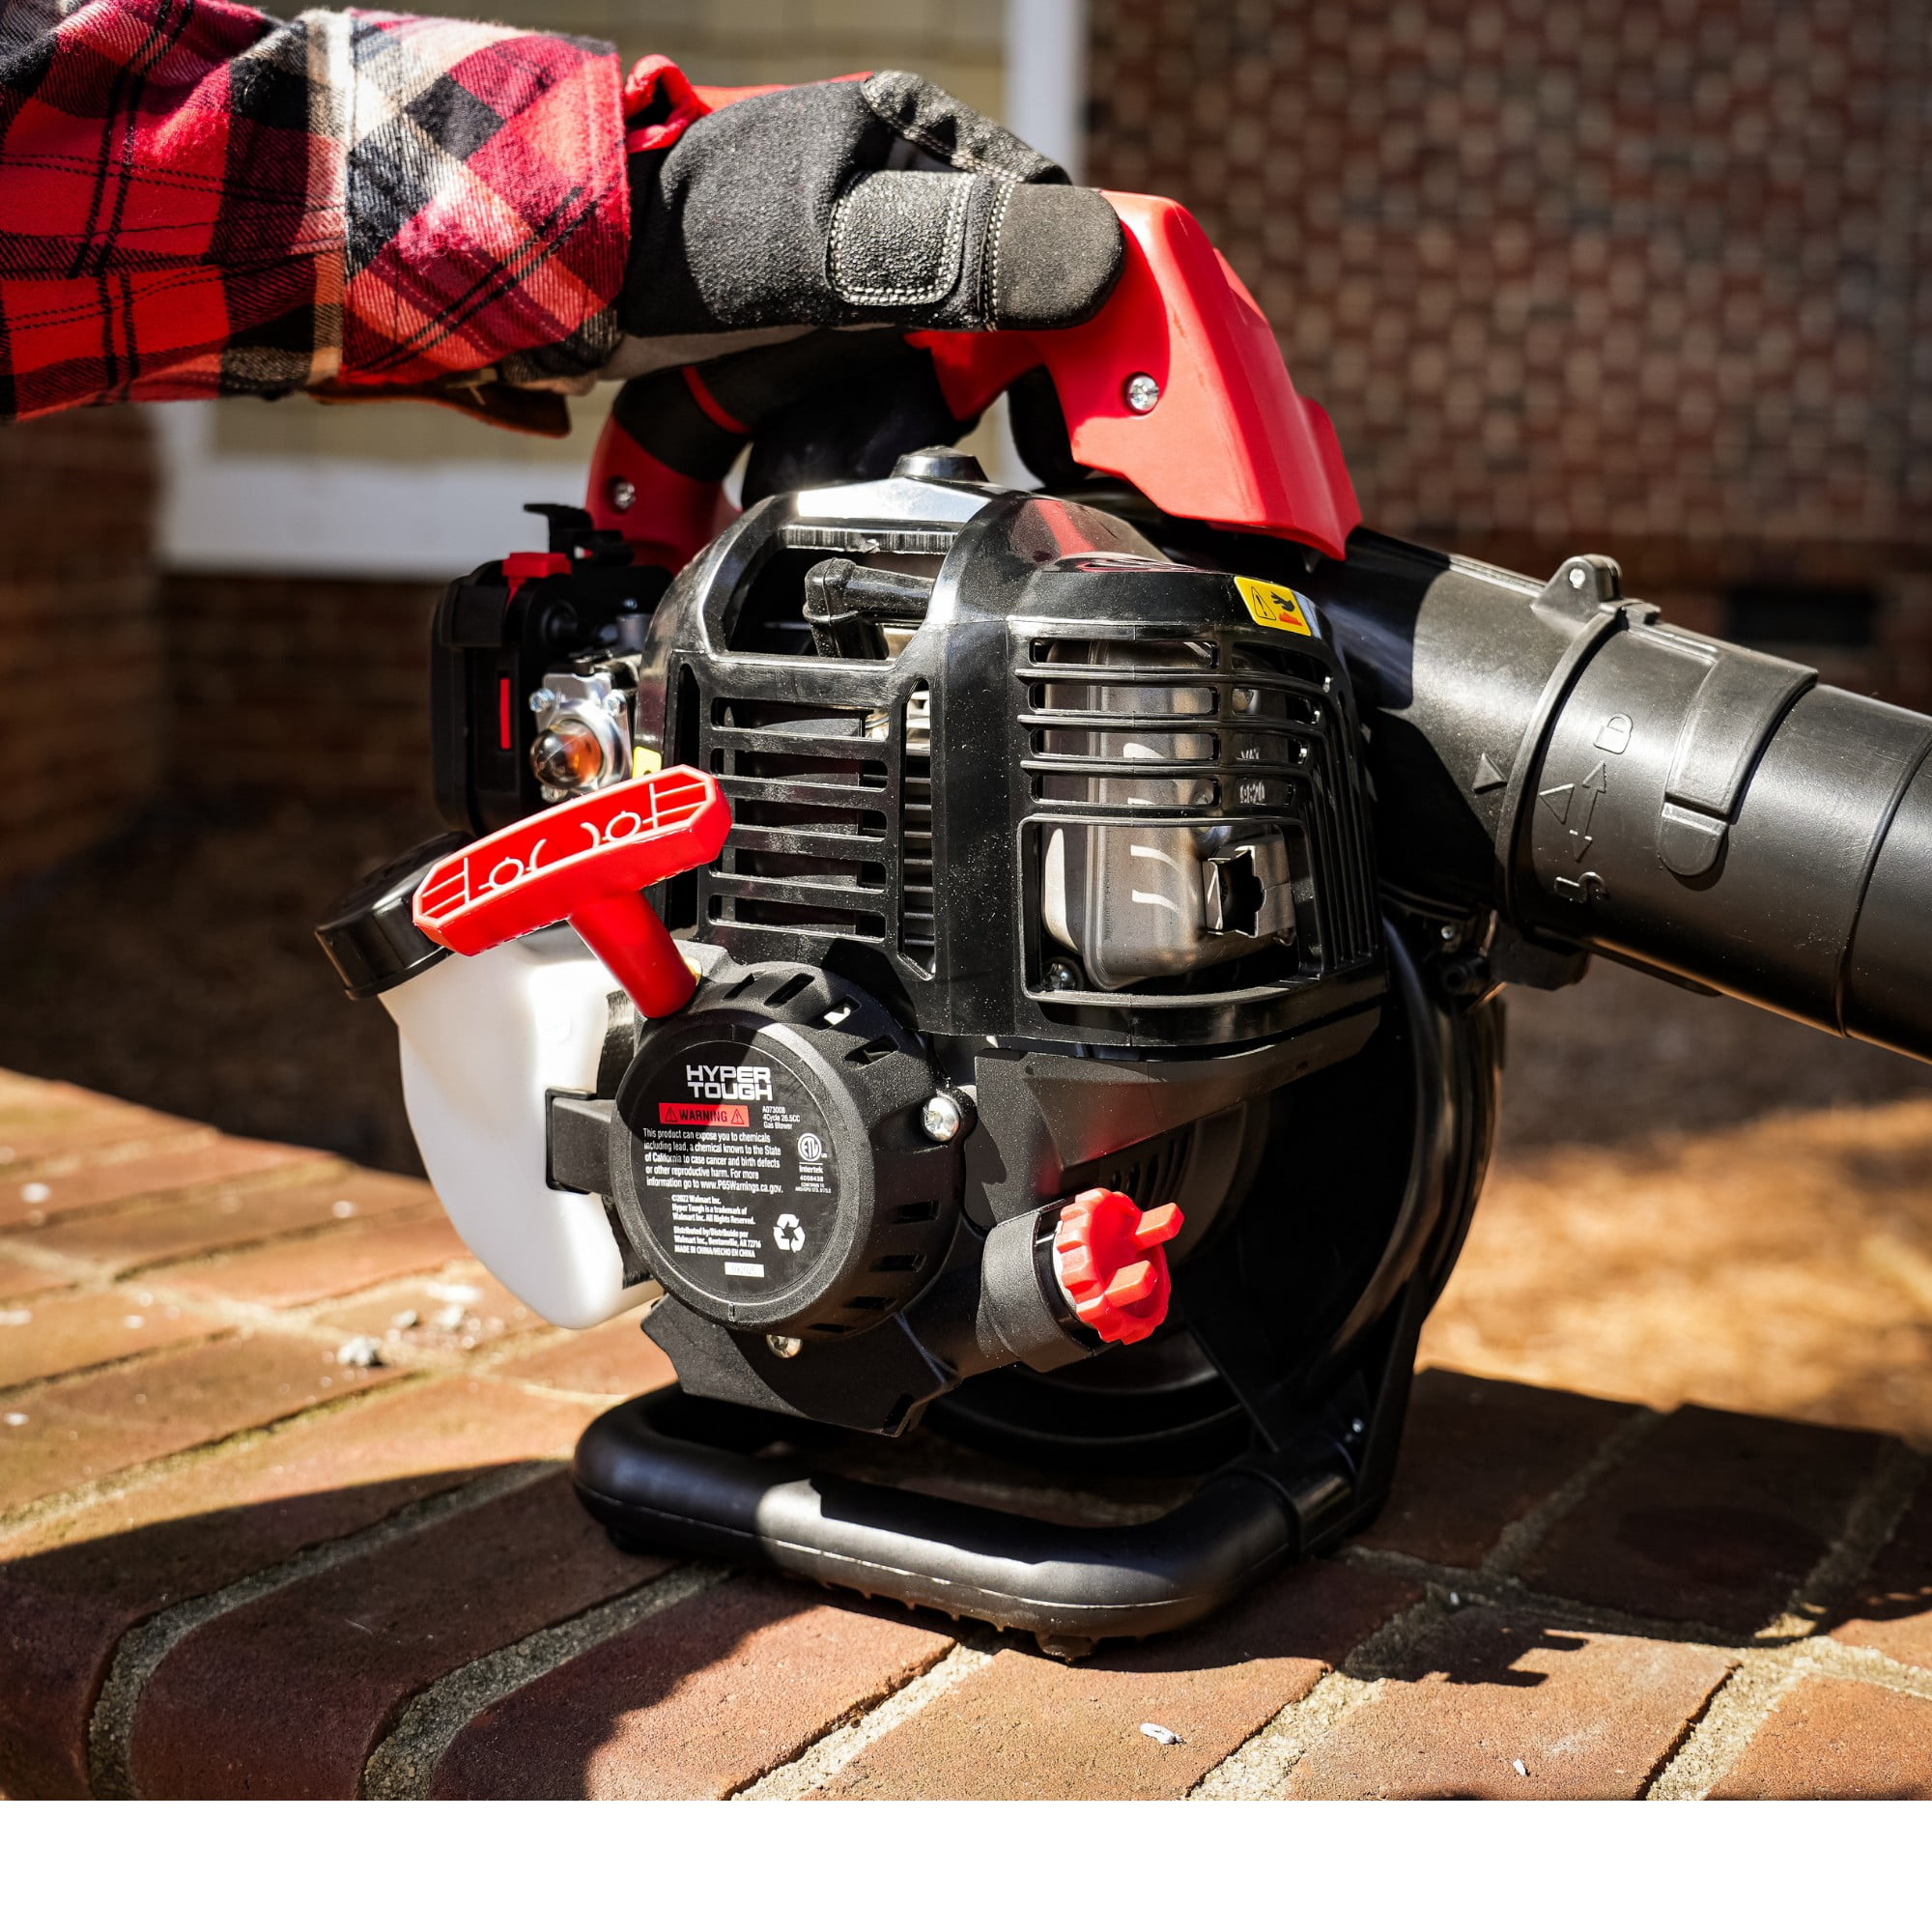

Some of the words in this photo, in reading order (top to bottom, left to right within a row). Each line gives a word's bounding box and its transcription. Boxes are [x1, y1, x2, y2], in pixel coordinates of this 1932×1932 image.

[686, 1065, 771, 1083] HYPER
[688, 1082, 773, 1101] TOUGH
[679, 1109, 727, 1122] WARNING
[643, 1128, 656, 1138] This
[658, 1129, 681, 1140] product
[696, 1132, 717, 1141] expose
[718, 1133, 730, 1142] you
[731, 1132, 737, 1141] to
[739, 1132, 770, 1143] chemicals
[644, 1141, 671, 1152] including
[673, 1142, 688, 1152] lead,
[695, 1143, 722, 1153] chemical
[723, 1144, 744, 1153] known
[745, 1145, 752, 1154] to
[753, 1145, 763, 1155] the
[765, 1145, 781, 1156] State
[645, 1152, 651, 1162] of
[652, 1153, 681, 1163] California
[683, 1155, 690, 1163] to
[706, 1157, 727, 1165] cancer
[728, 1156, 739, 1166] and
[741, 1157, 756, 1167] birth
[757, 1158, 780, 1168] defects
[645, 1166, 652, 1174] or
[654, 1165, 670, 1175] other
[672, 1166, 710, 1177] reproductive
[711, 1168, 729, 1178] harm.
[730, 1169, 741, 1178] For
[742, 1171, 759, 1179] more
[799, 1165, 823, 1173] Intertek
[647, 1177, 682, 1188] information
[683, 1180, 691, 1189] go
[693, 1179, 699, 1188] to
[700, 1180, 783, 1194] www.P65Warnings.ca.gov.
[689, 1195, 711, 1203] Walmart
[672, 1203, 687, 1213] Hyper
[688, 1204, 705, 1213] Tough
[714, 1206, 741, 1214] trademark
[741, 1207, 747, 1215] of
[673, 1212, 695, 1221] Walmart
[714, 1214, 730, 1224] Rights
[730, 1216, 755, 1224] Reserved.
[673, 1226, 702, 1235] Distributed
[674, 1235, 696, 1244] Walmart
[675, 1245, 690, 1253] MADE
[691, 1246, 696, 1254] IN
[739, 1249, 755, 1257] CHINA
